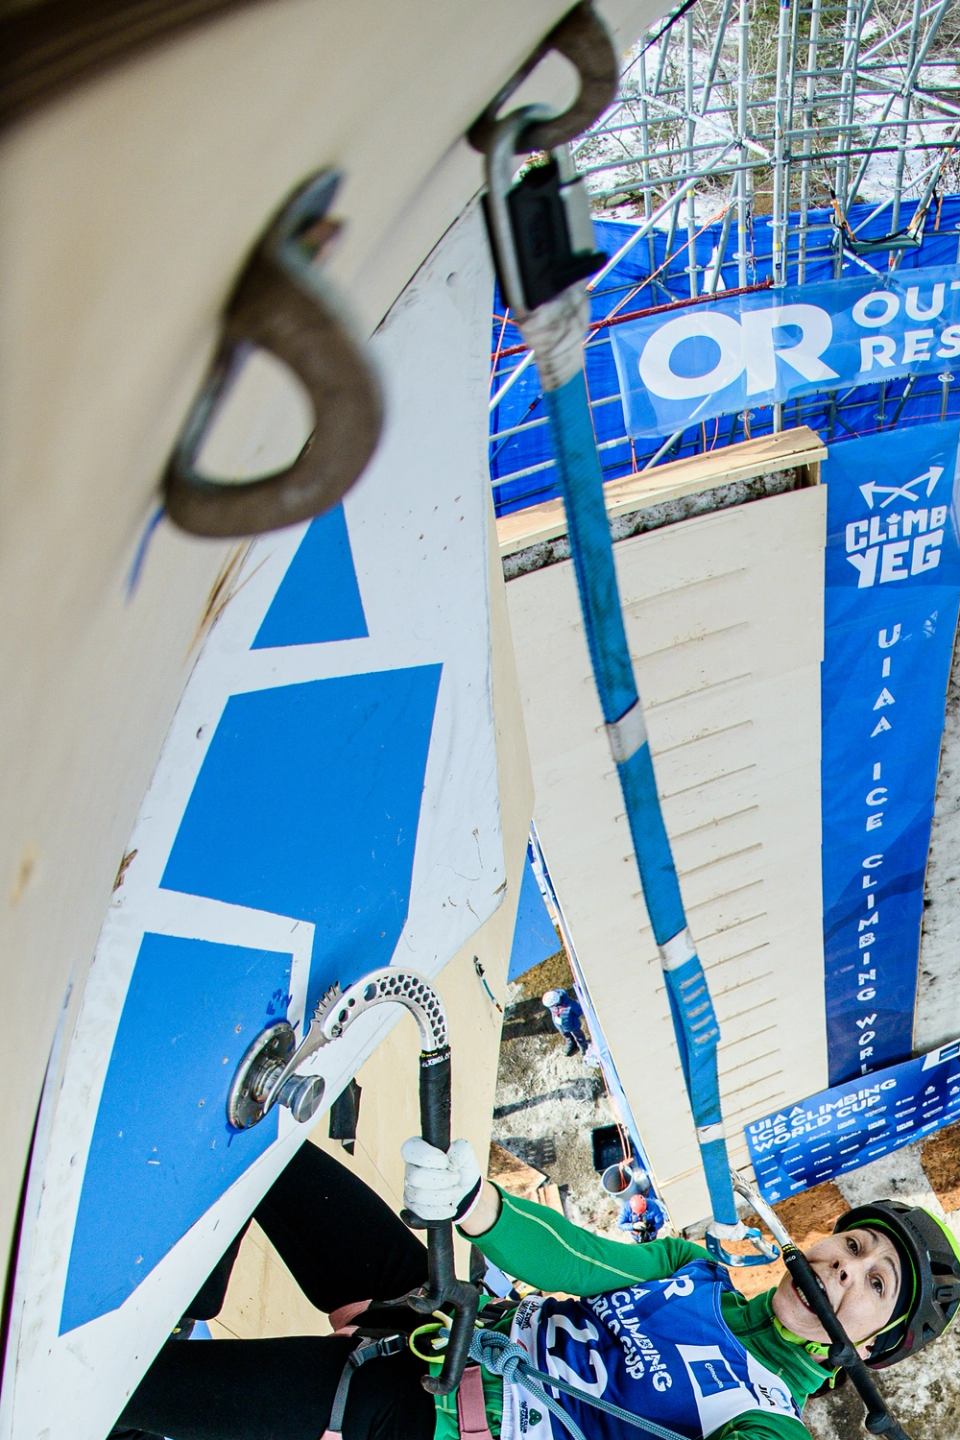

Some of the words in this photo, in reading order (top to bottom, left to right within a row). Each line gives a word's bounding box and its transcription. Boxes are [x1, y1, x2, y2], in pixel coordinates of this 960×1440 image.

[638, 303, 840, 400] OR
[844, 504, 947, 553] CLIMB
[846, 530, 945, 589] YEG
[869, 622, 902, 739] UIAA
[866, 762, 888, 831] ICE
[857, 854, 883, 1002] CLIMBING
[749, 1106, 805, 1135] UIAA
[751, 1122, 787, 1145] ICE
[791, 1079, 897, 1126] CLIMBING
[754, 1114, 832, 1153] WORLD
[836, 1095, 881, 1119] CUP
[611, 1290, 673, 1393] CLIMBING
